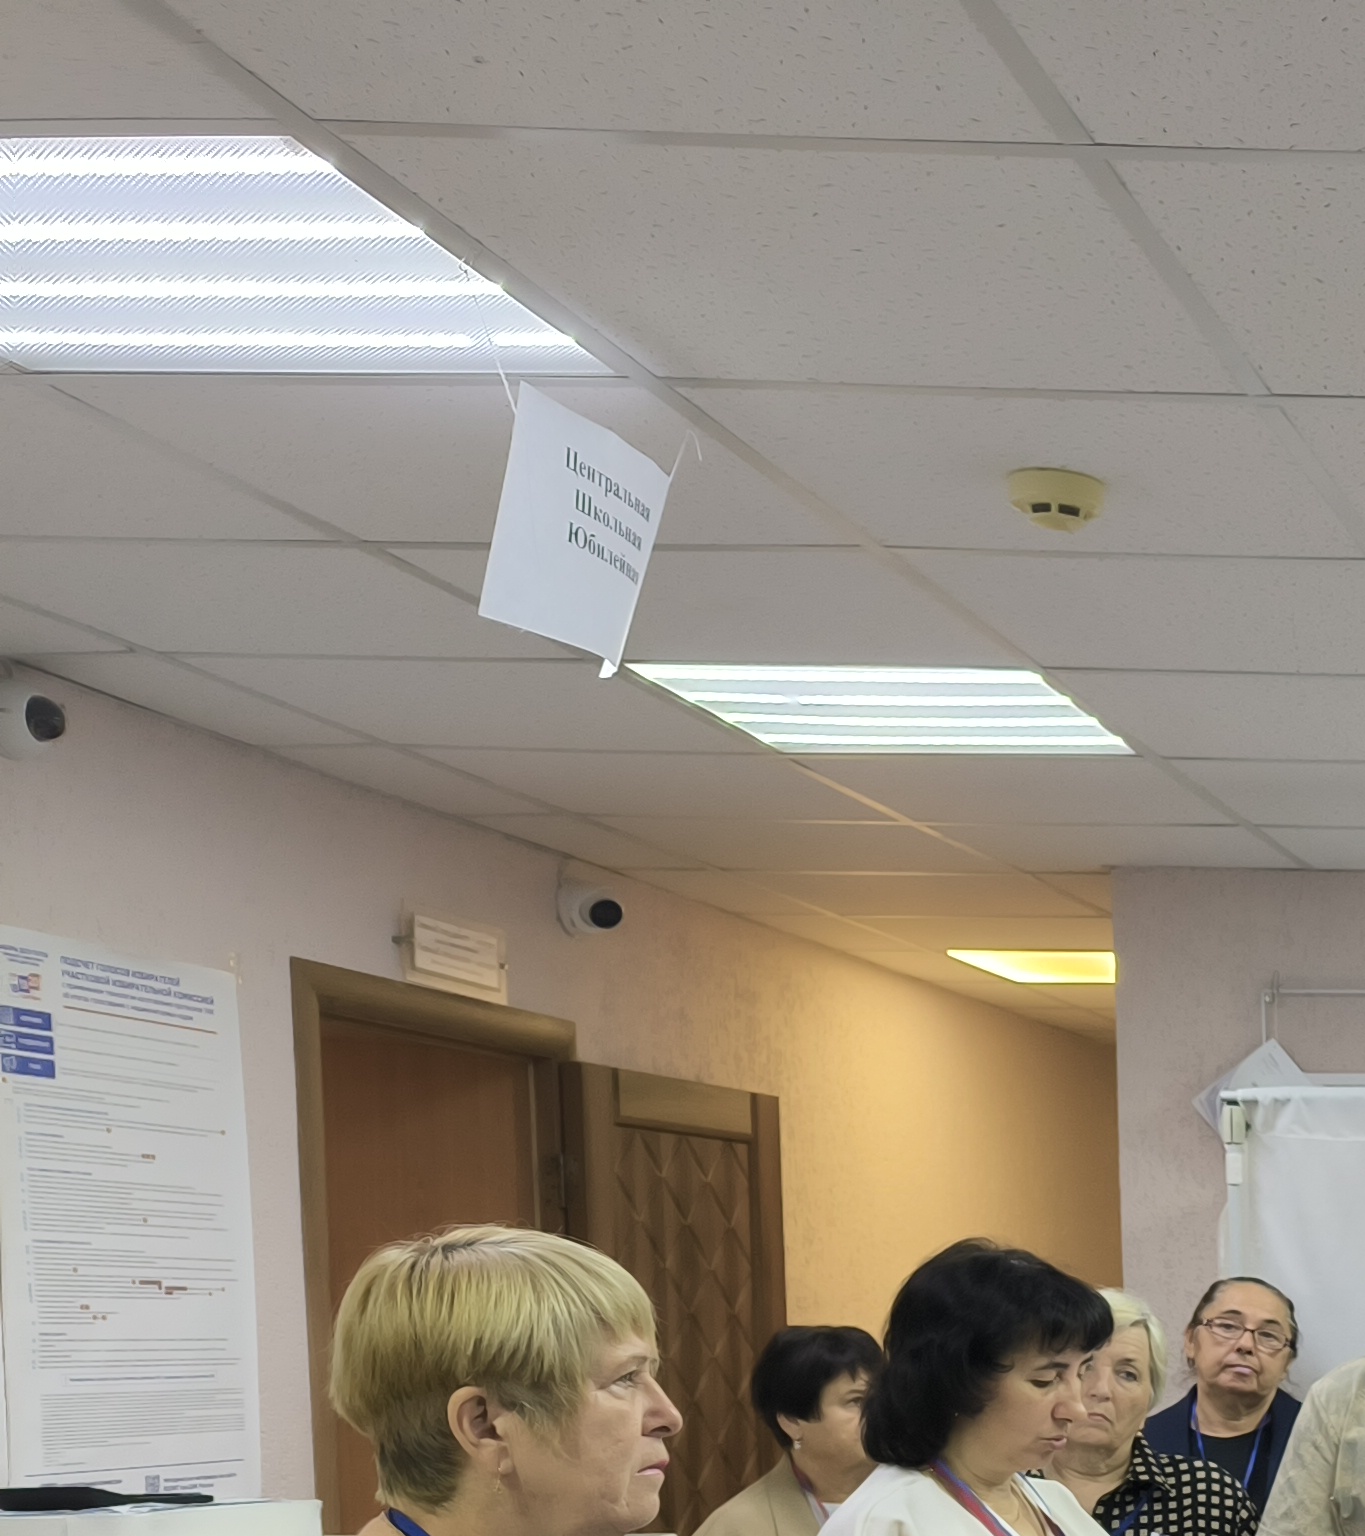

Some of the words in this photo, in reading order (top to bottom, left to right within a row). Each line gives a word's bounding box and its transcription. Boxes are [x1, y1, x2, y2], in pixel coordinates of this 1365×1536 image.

[565, 446, 651, 522] Центральная
[575, 488, 642, 551] Школьная
[568, 521, 639, 586] Юбилейная
